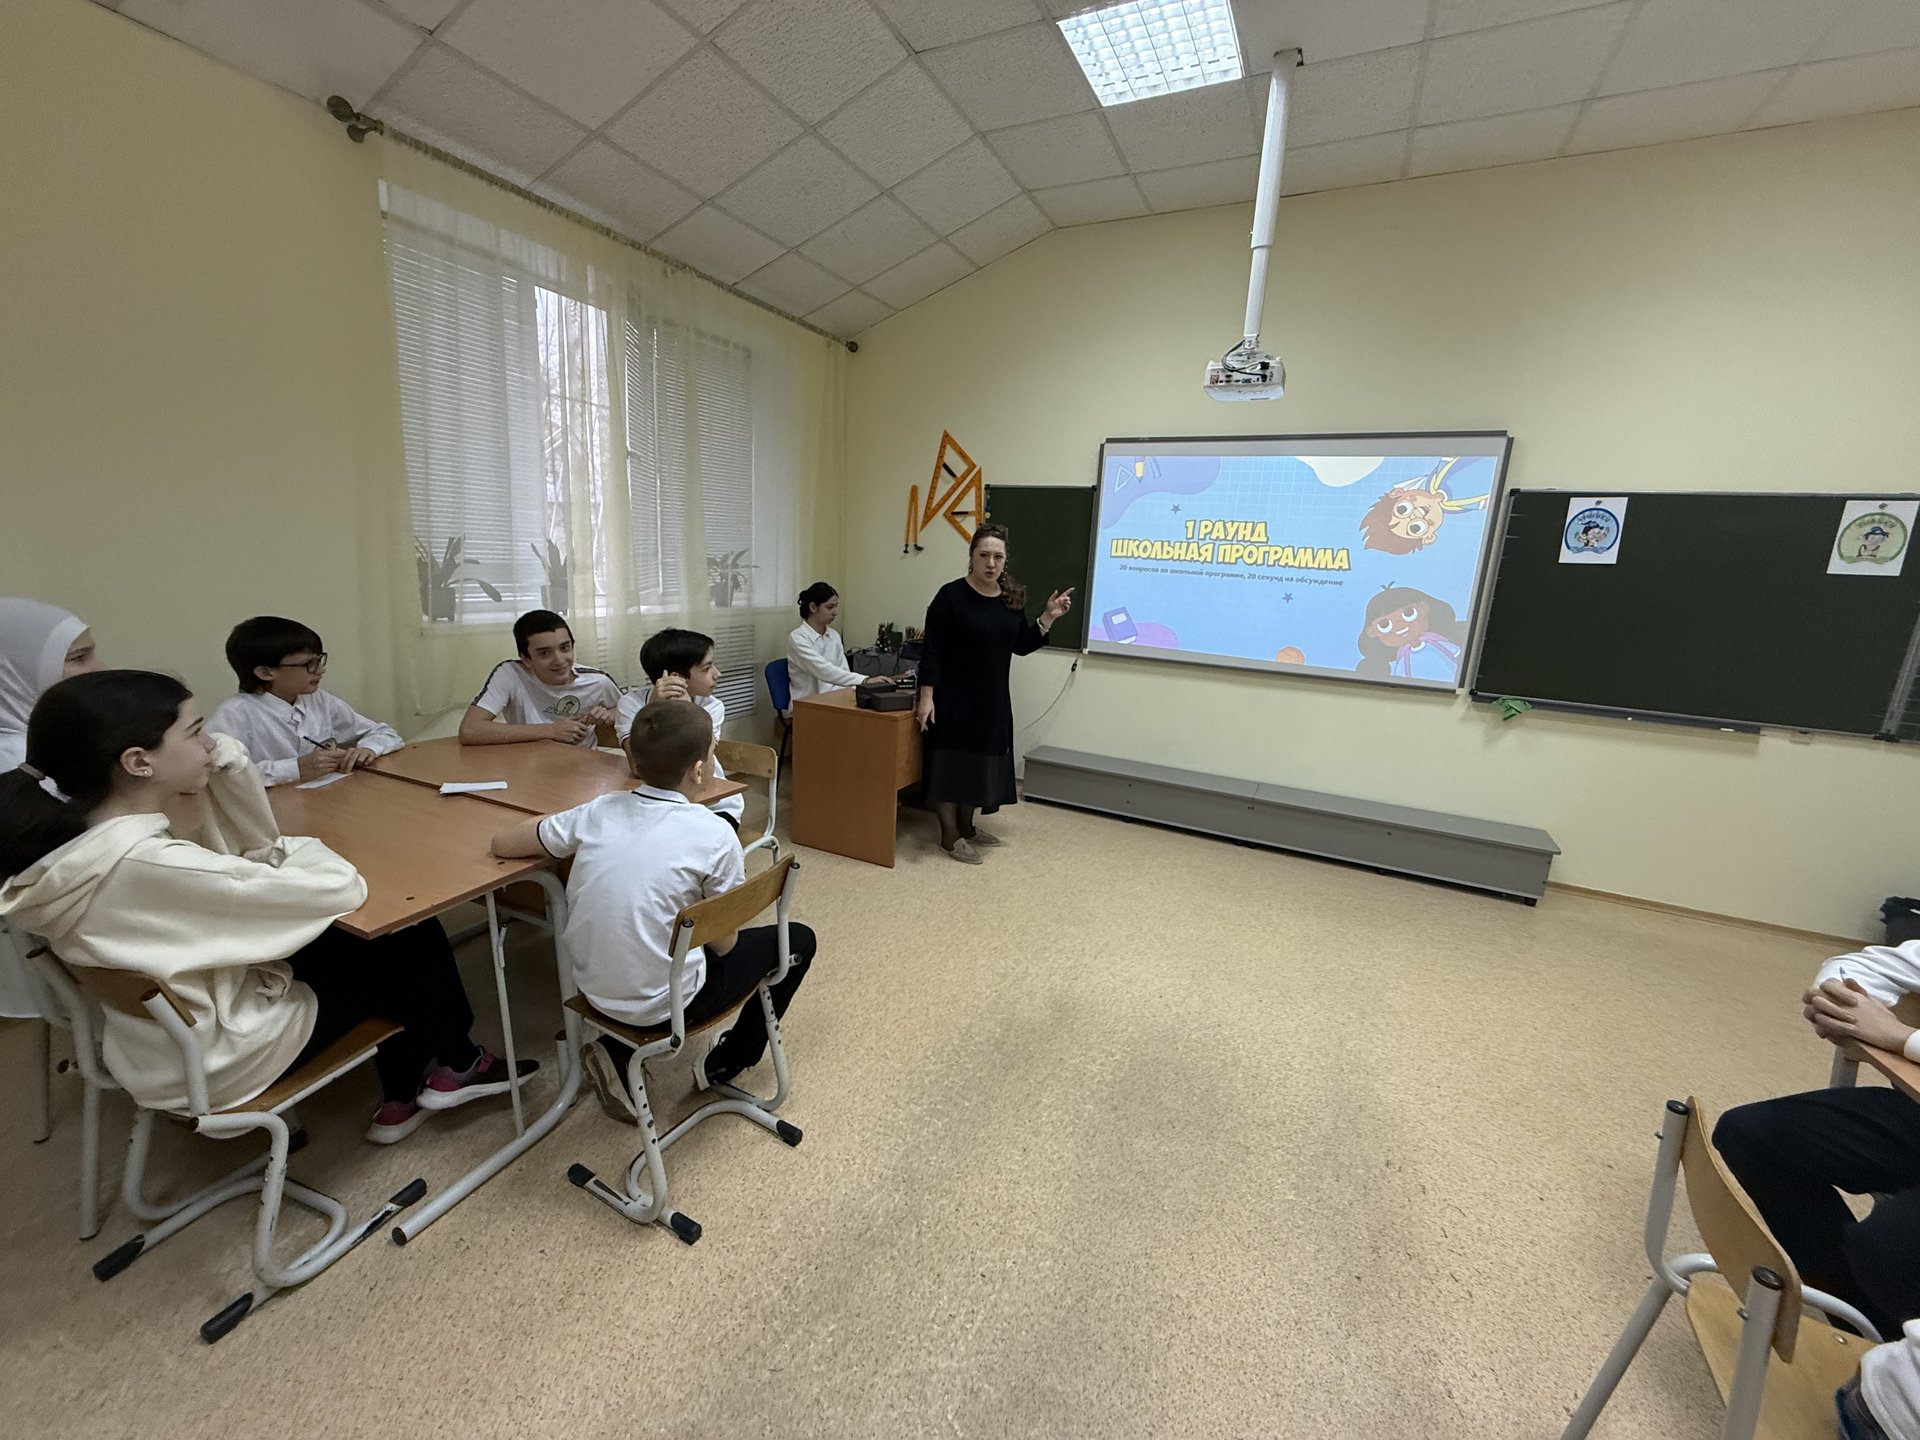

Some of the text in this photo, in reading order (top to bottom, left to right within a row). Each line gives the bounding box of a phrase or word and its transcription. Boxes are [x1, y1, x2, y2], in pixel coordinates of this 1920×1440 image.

[1185, 519, 1269, 543] 1 РАУНД
[1110, 538, 1351, 571] ШКОЛЬНАЯ ПРОГРАММА
[1205, 571, 1246, 580] программе,
[1247, 572, 1257, 580] 20
[1257, 574, 1284, 584] секунд
[1295, 576, 1344, 587] обсуждение
